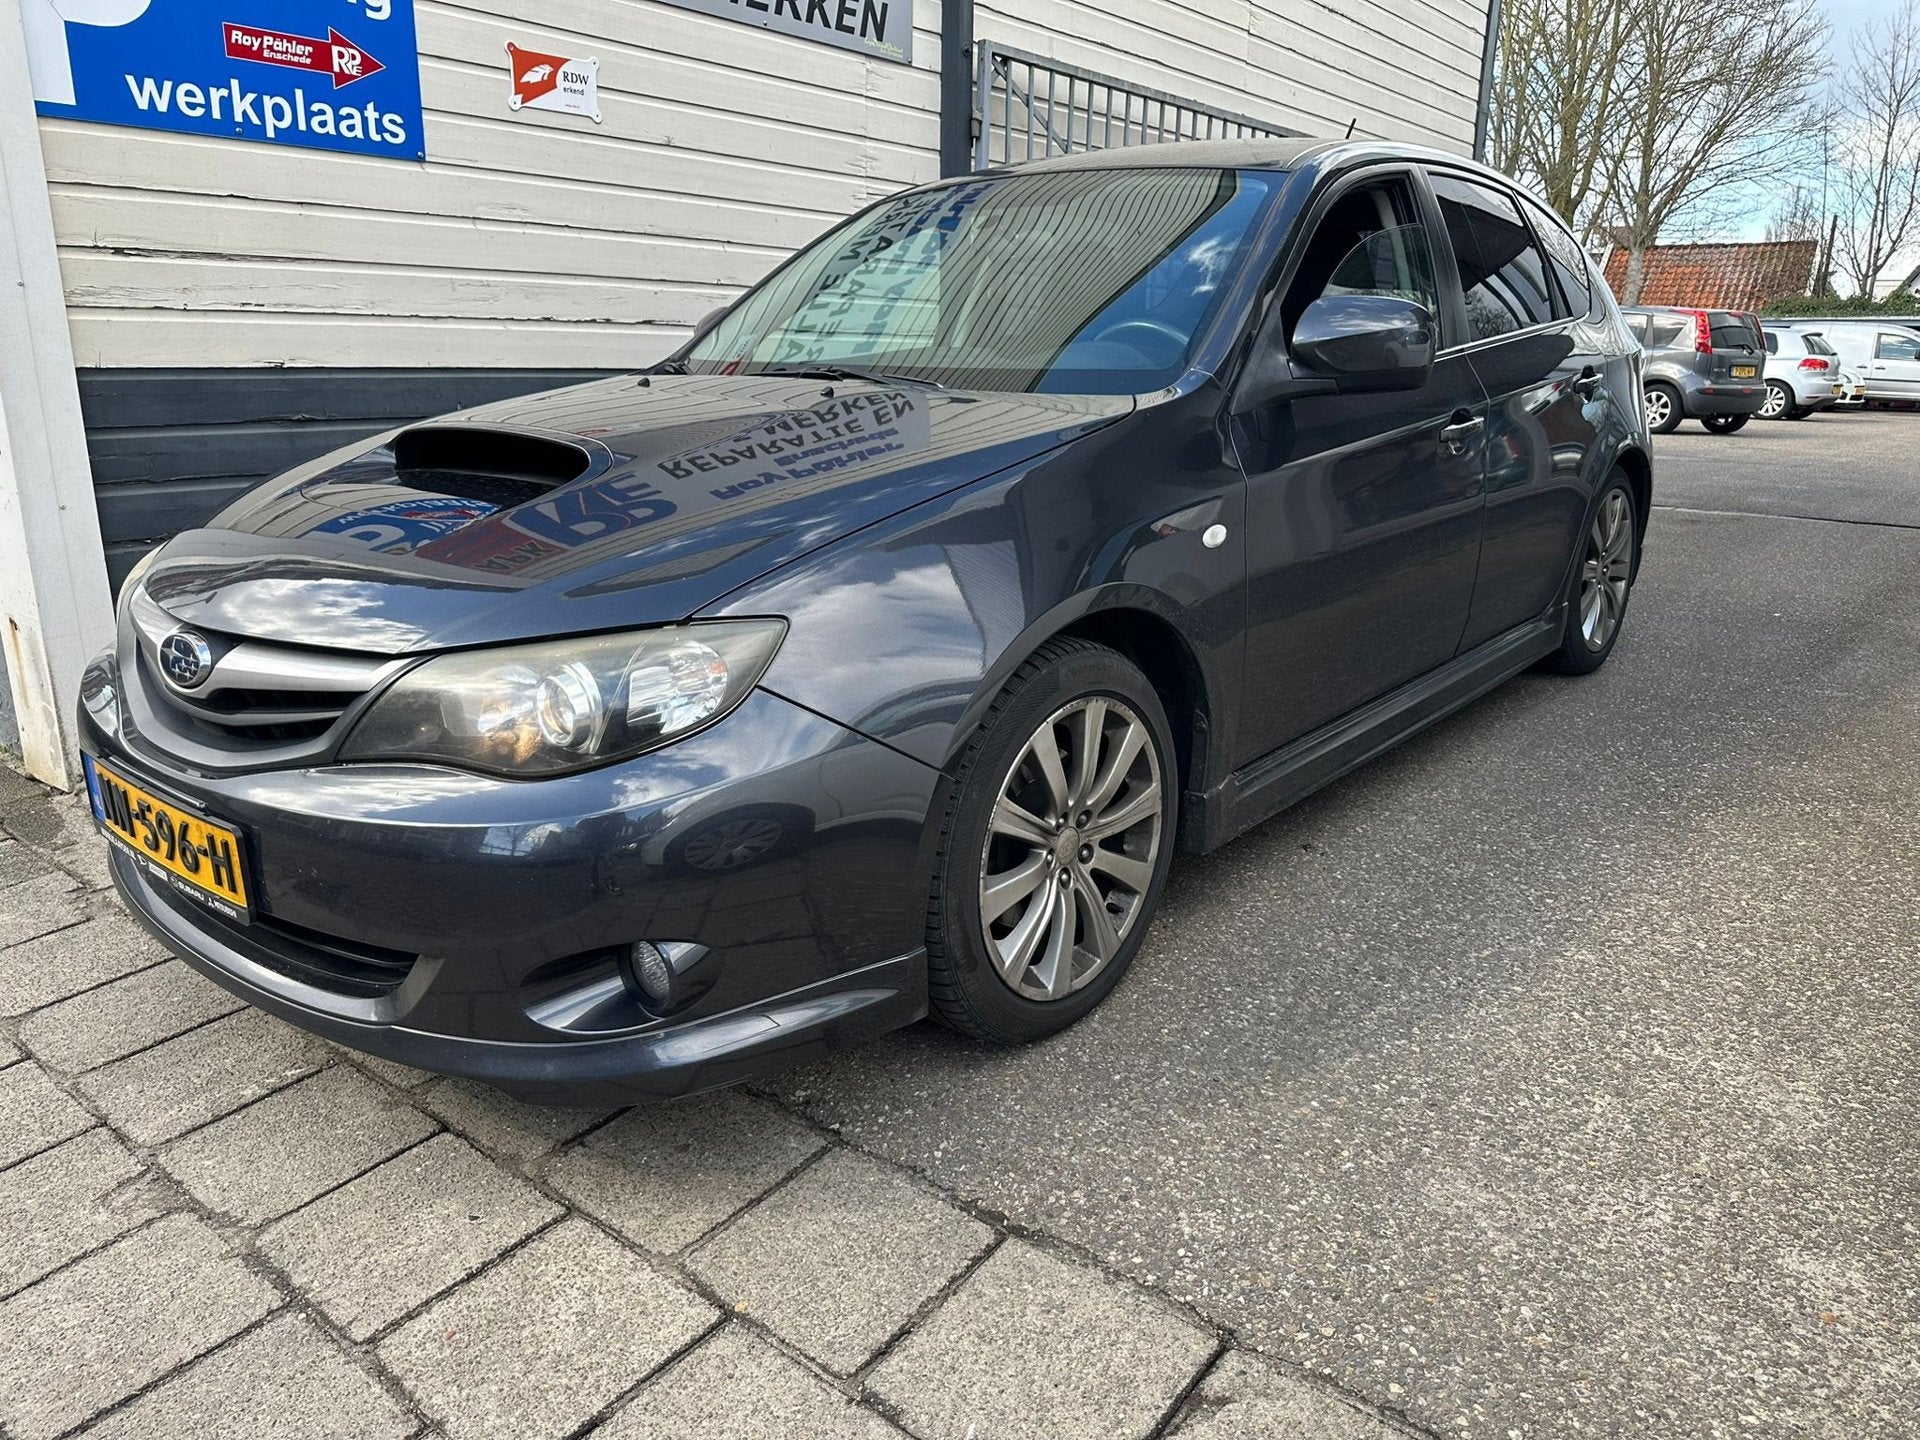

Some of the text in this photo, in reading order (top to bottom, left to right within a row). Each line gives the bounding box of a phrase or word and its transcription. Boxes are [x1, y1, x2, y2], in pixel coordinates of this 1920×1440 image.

[231, 30, 313, 56] Roy Pähler
[263, 50, 312, 65] Enschede
[562, 71, 589, 86] RDW
[563, 86, 584, 96] erkend
[124, 74, 406, 145] werkplaats
